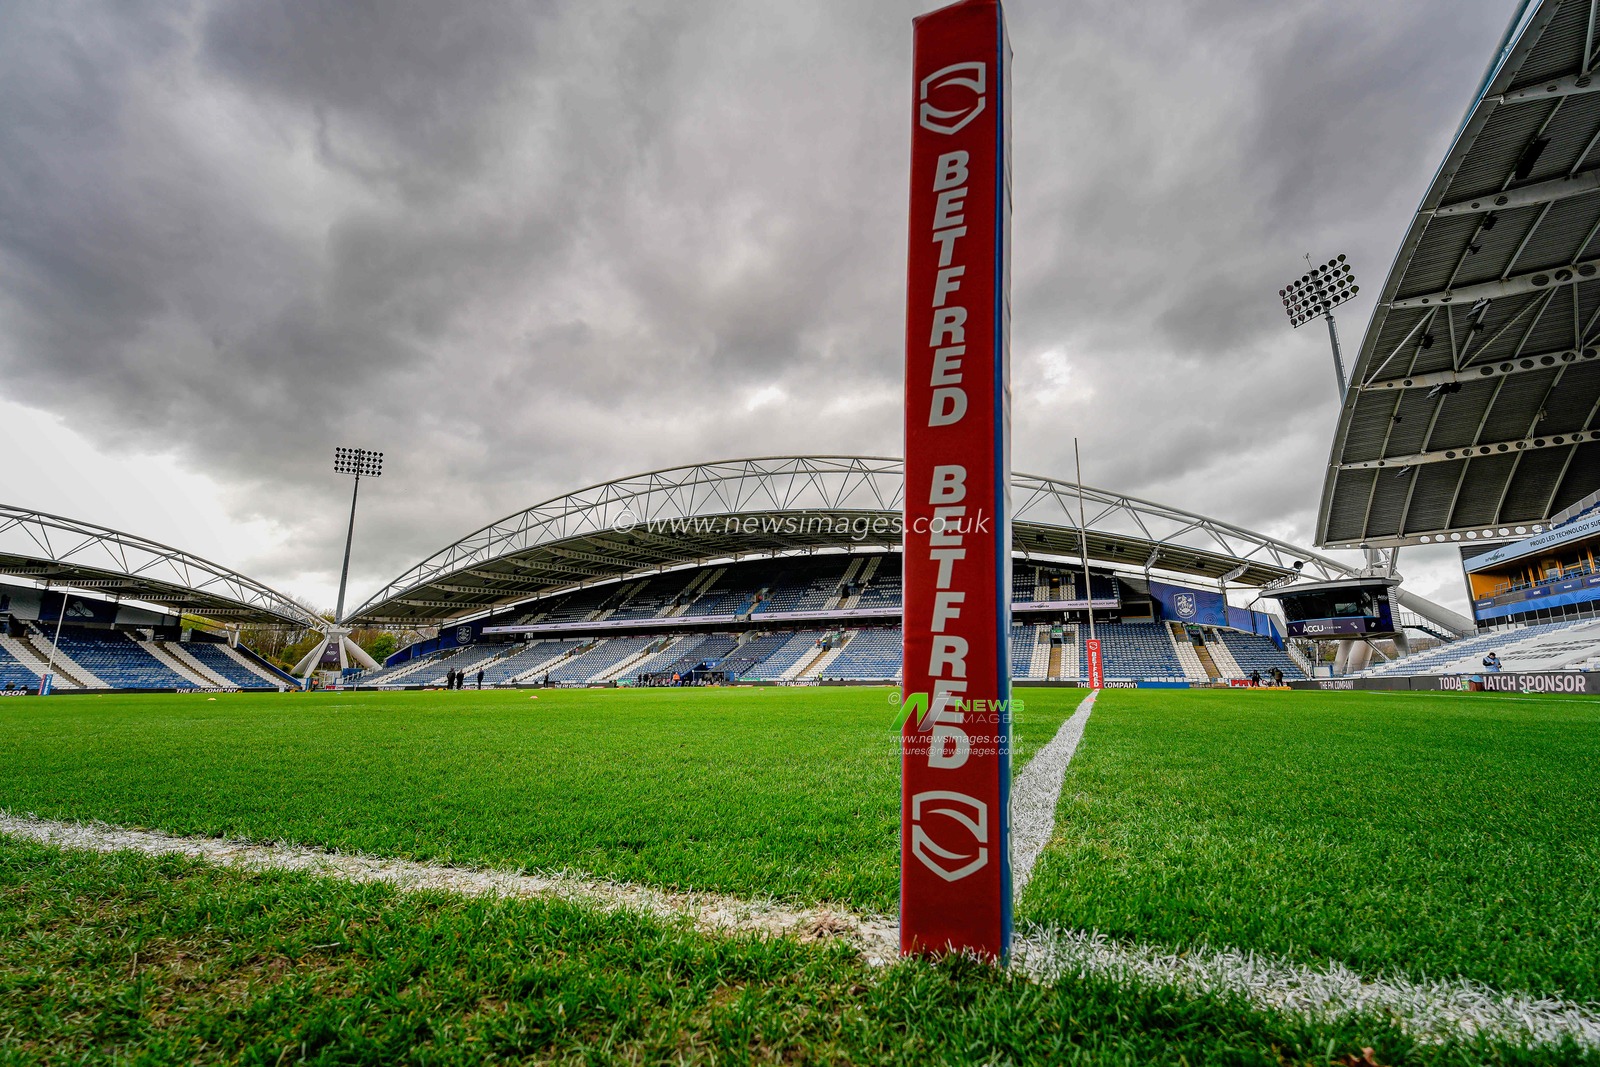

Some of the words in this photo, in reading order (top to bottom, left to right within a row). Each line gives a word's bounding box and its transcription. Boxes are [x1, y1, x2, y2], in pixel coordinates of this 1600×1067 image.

[928, 150, 970, 427] BETFRED
[1546, 534, 1556, 542] LED
[1556, 523, 1590, 539] TECHNOLOGY
[927, 464, 970, 770] BETFRED
[1091, 651, 1099, 687] BETFRED
[1519, 674, 1586, 692] SPONSOR
